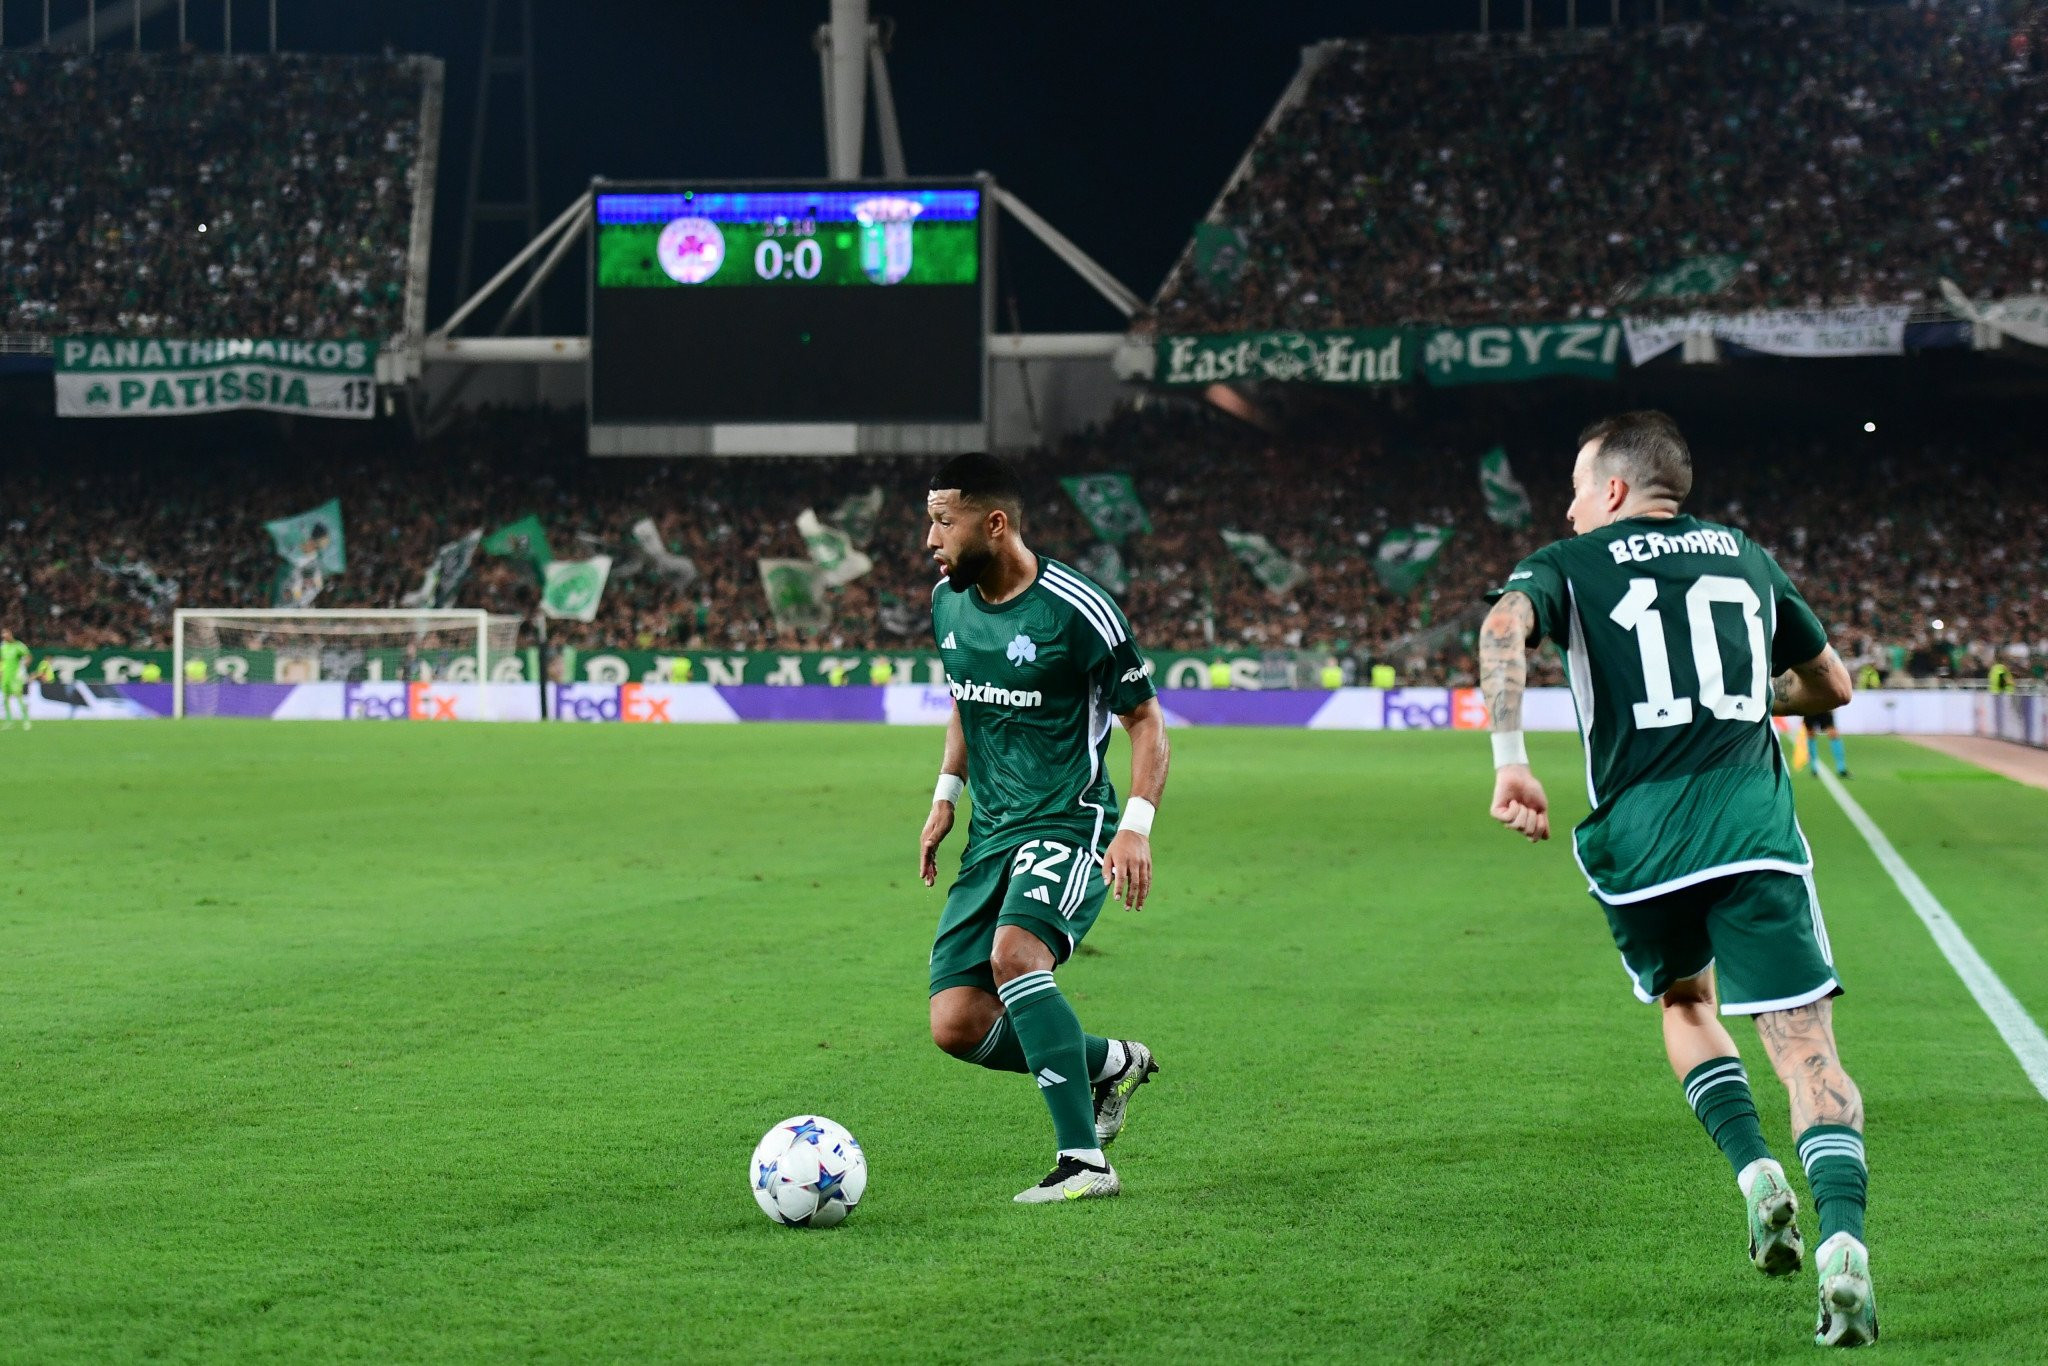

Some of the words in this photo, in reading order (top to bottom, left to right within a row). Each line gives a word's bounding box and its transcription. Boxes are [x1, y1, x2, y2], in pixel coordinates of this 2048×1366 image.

[754, 239, 823, 280] 0:0
[64, 338, 367, 368] PANATHINAIKOS
[1166, 335, 1251, 383] East
[1316, 335, 1402, 382] End
[1467, 323, 1621, 367] GYZI
[118, 371, 310, 409] PATISSIA
[343, 381, 370, 412] 13
[1608, 529, 1740, 565] BERNARD
[1609, 574, 1768, 730] 10
[344, 682, 458, 721] FedEx
[556, 682, 672, 722] FedEx
